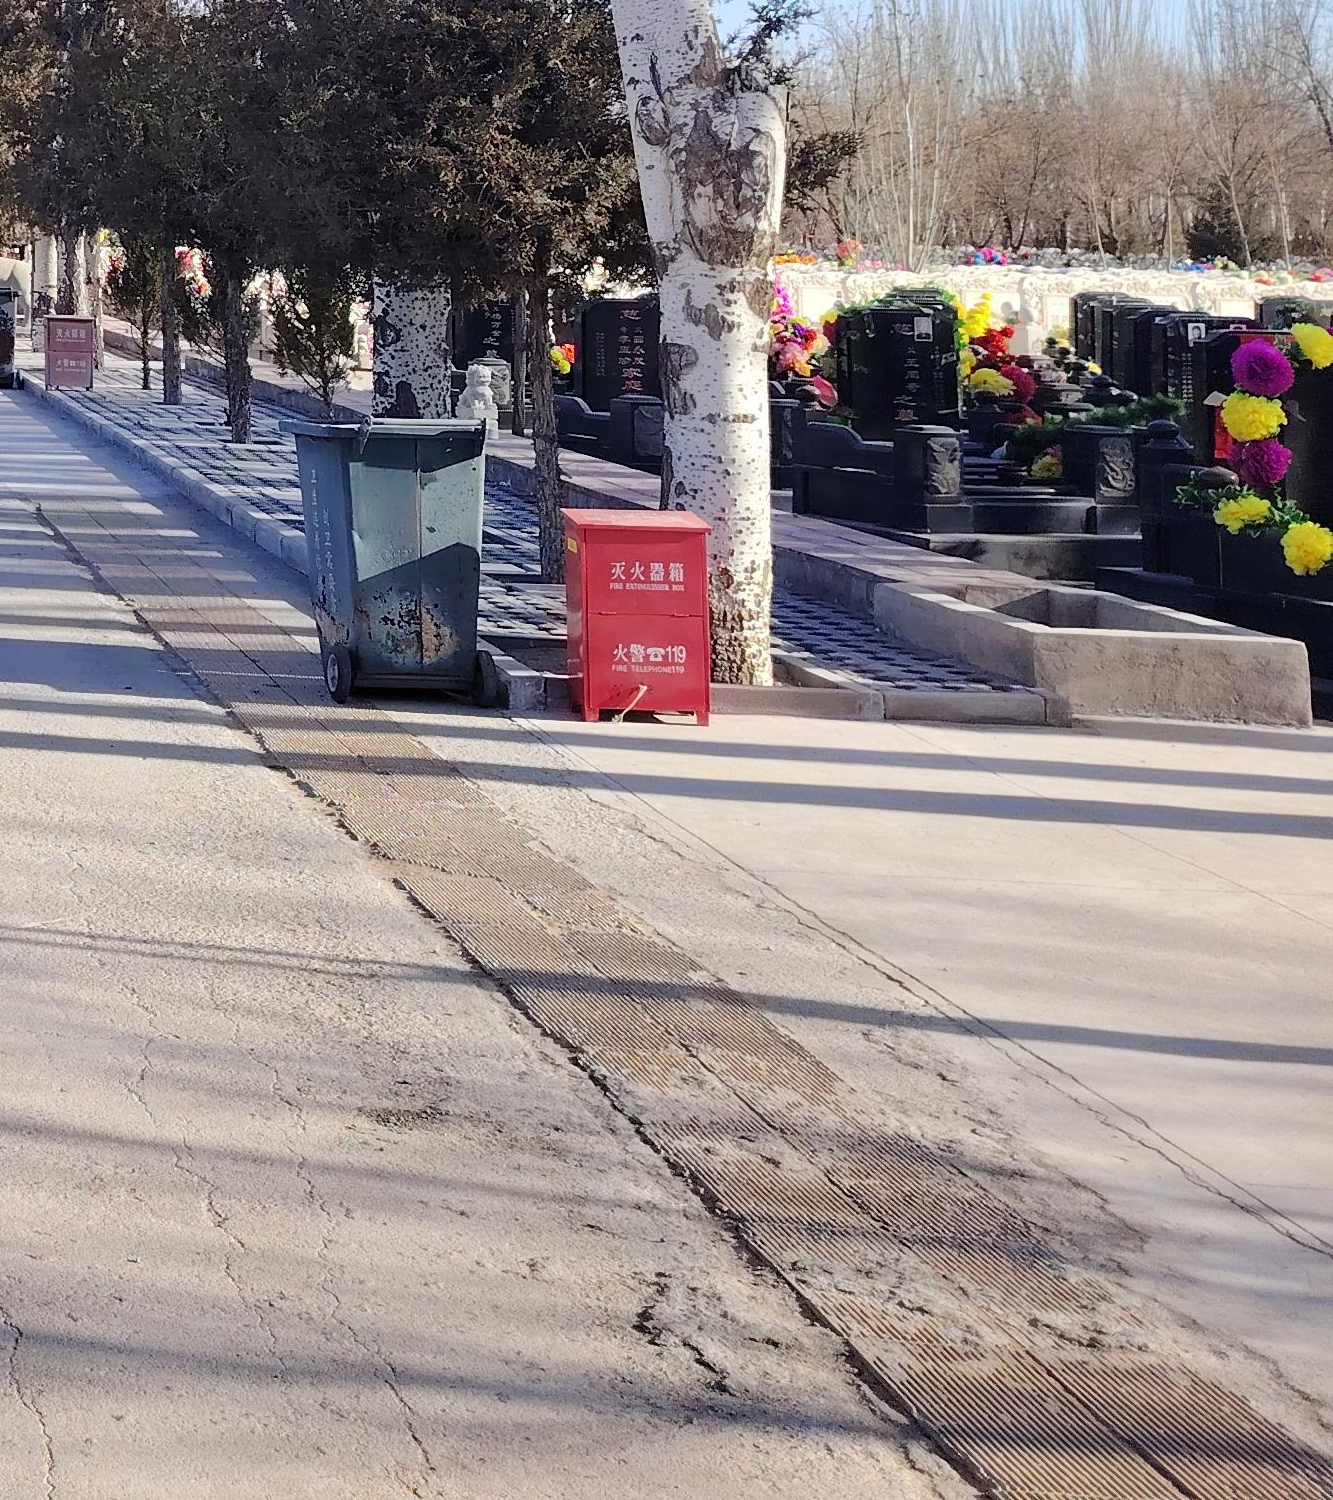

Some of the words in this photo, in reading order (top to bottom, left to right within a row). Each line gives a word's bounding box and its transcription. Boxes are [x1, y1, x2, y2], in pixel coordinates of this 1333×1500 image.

[610, 561, 684, 582] 灭火器箱
[609, 582, 624, 590] FIRE
[625, 583, 670, 591] EXTINGUISHER
[611, 664, 628, 672] FIRE
